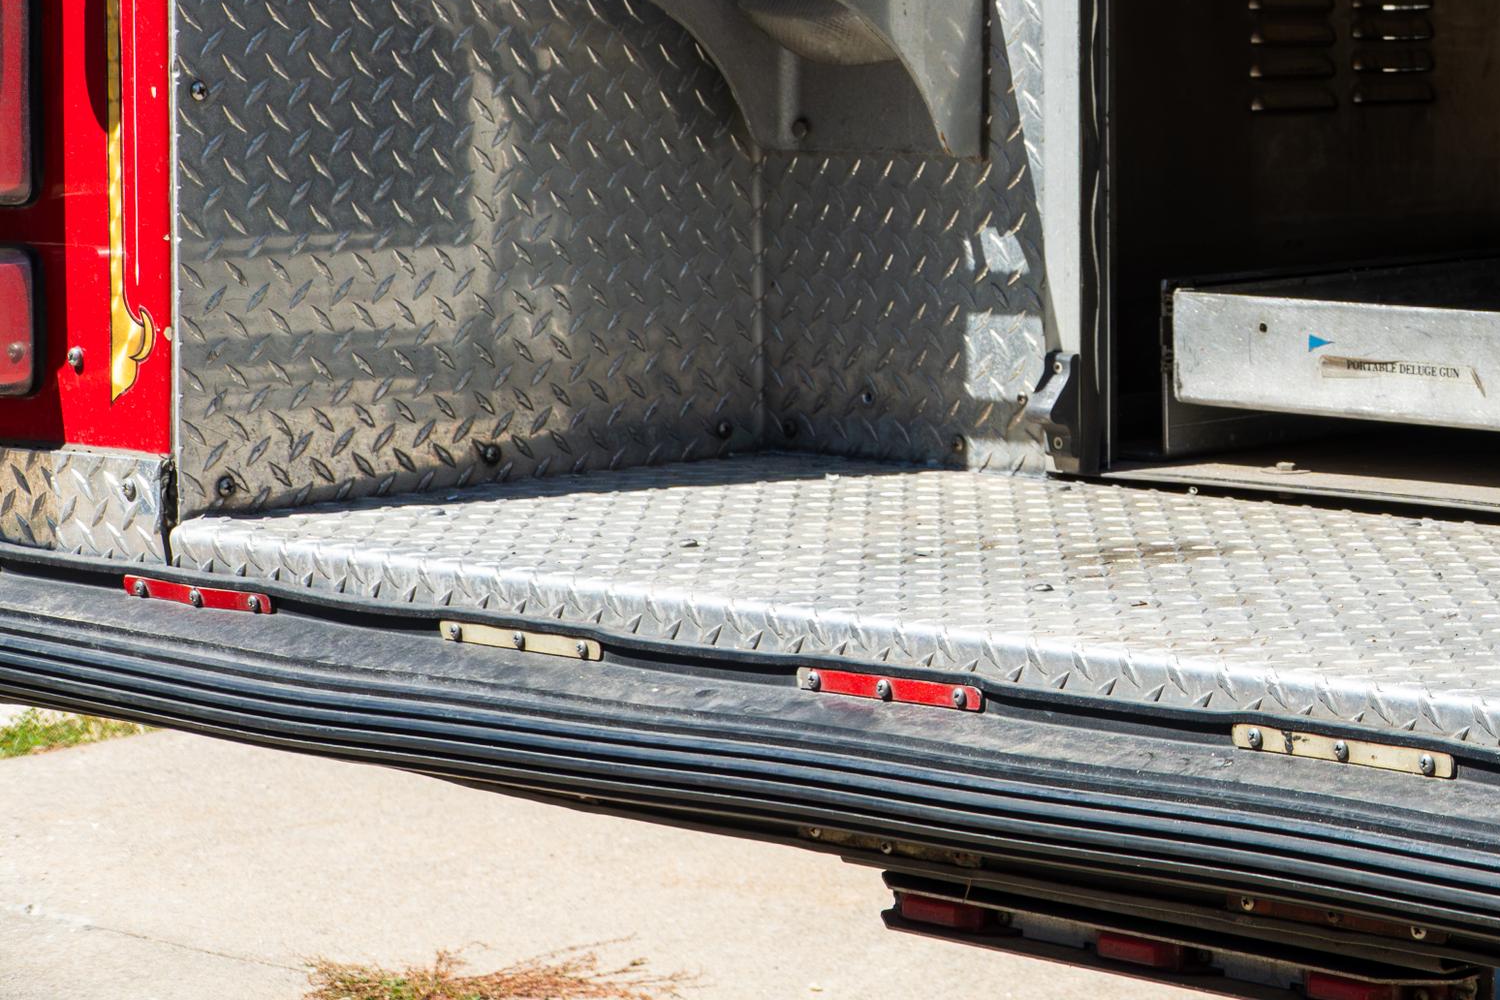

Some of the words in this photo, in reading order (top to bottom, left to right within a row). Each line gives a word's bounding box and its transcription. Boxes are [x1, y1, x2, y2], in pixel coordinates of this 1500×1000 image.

[1346, 359, 1397, 374] PORTABLE
[1399, 364, 1436, 377] DELUGE
[1439, 366, 1460, 379] GUN
